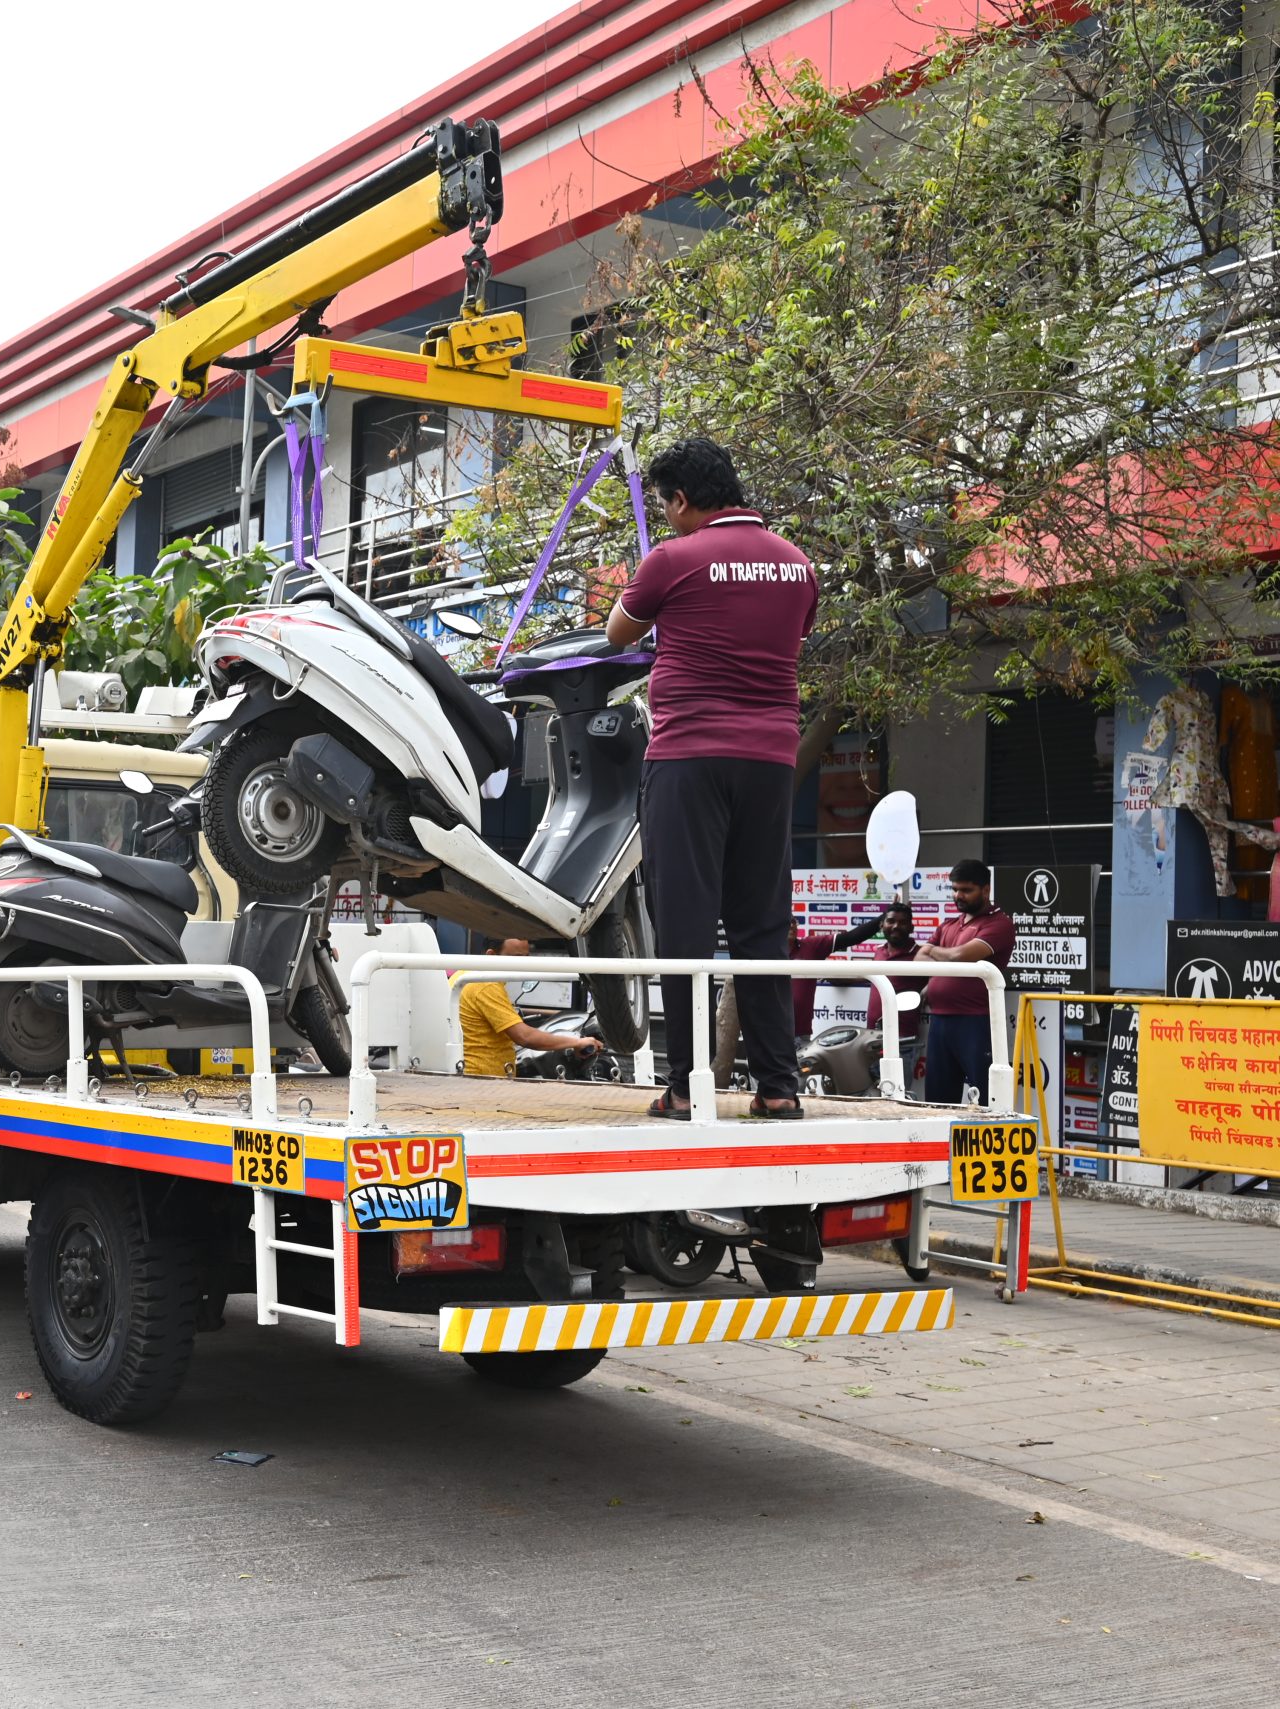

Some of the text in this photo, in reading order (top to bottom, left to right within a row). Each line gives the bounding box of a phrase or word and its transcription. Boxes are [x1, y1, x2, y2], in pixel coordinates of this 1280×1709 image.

[47, 467, 82, 541] HYVA CRANE
[709, 562, 807, 582] ON TRAFFIC DUTY
[807, 874, 839, 894] ई-सेवा
[842, 874, 859, 895] केंद्र
[1190, 927, 1279, 939] adv.nitinkshirsagar@gmail.com
[1062, 941, 1070, 952] &
[1046, 953, 1083, 965] COURT
[1020, 969, 1042, 984] नोटरी
[814, 1004, 867, 1022] परी-चिंचवड
[1150, 1018, 1184, 1042] पिंपरी
[1188, 1020, 1238, 1045] चिंचवड
[1203, 1078, 1235, 1093] यांच्या
[1175, 1100, 1242, 1124] वाहतूक
[1189, 1125, 1222, 1143] पिंपरी
[1227, 1128, 1273, 1148] चिंचवड
[239, 1157, 288, 1185] 1236
[350, 1138, 459, 1184] STOP
[959, 1159, 1027, 1194] 1236
[350, 1180, 456, 1224] SIGNAL
